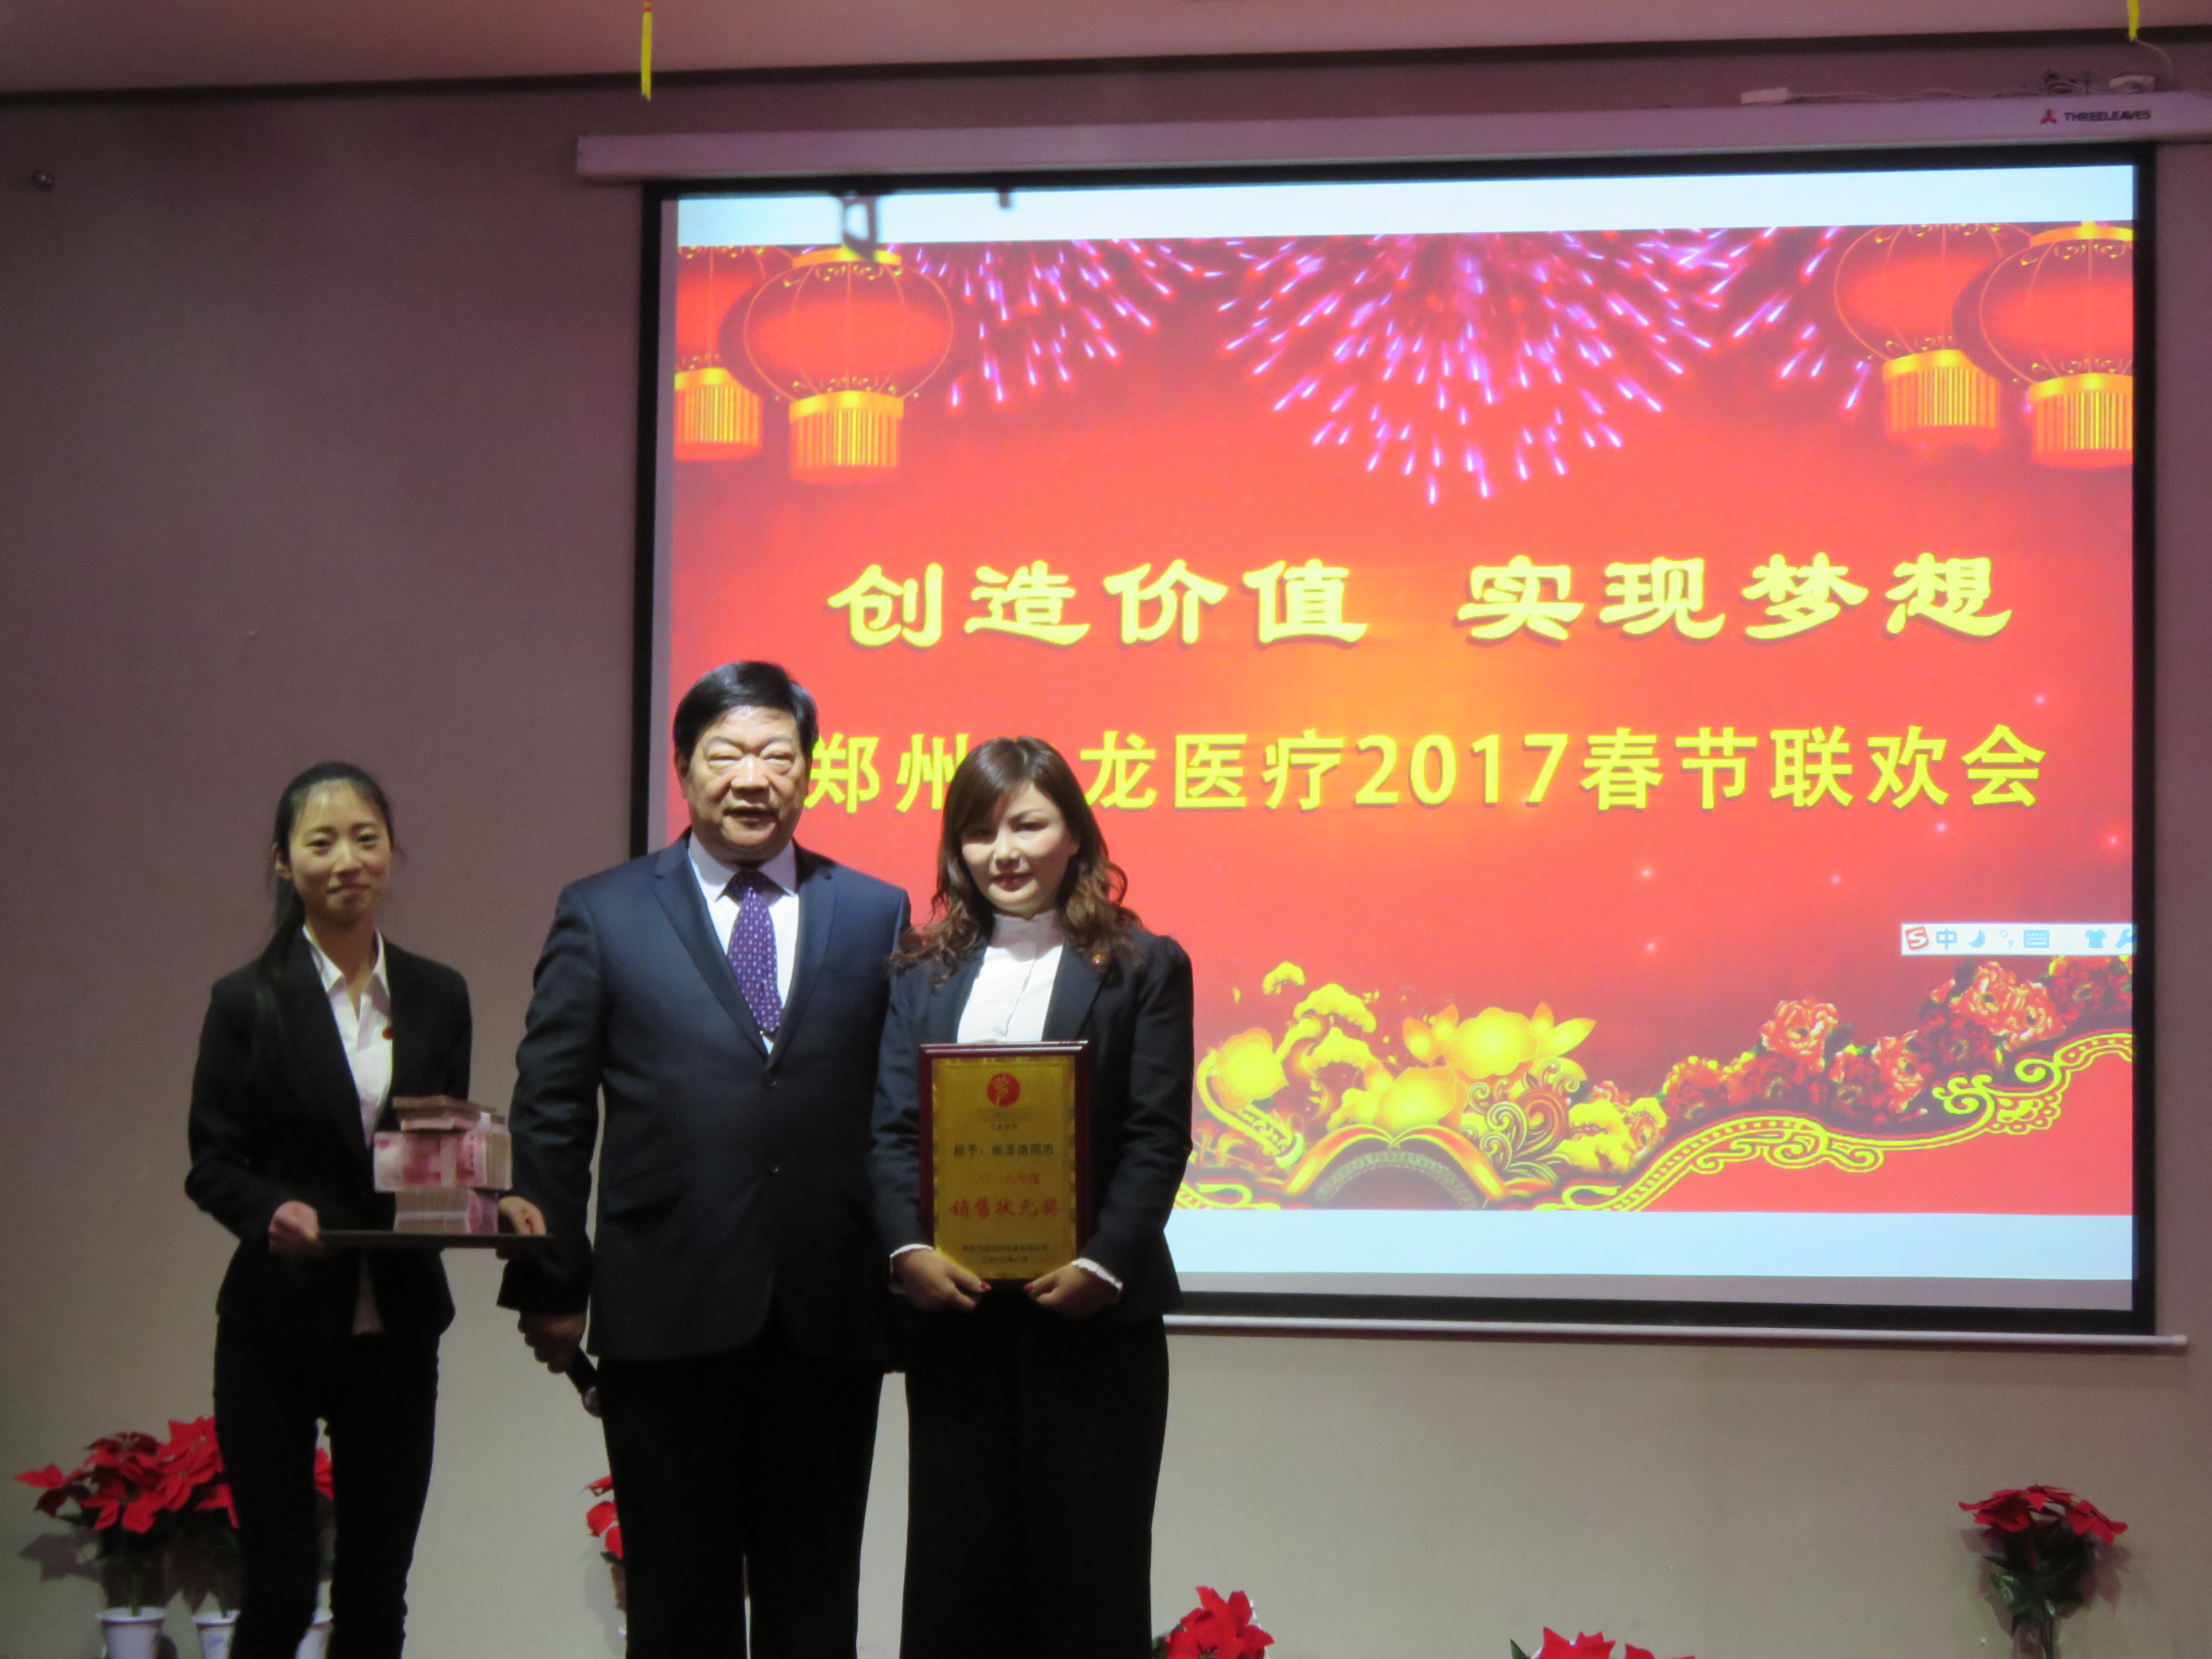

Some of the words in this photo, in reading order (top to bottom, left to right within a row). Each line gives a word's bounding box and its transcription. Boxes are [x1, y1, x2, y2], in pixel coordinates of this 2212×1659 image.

[827, 559, 1369, 648] 创造价值
[1456, 551, 2012, 641] 实现梦想
[804, 724, 2046, 813] 郑州龙医疗2017春节联欢会
[1936, 929, 1957, 950] 中
